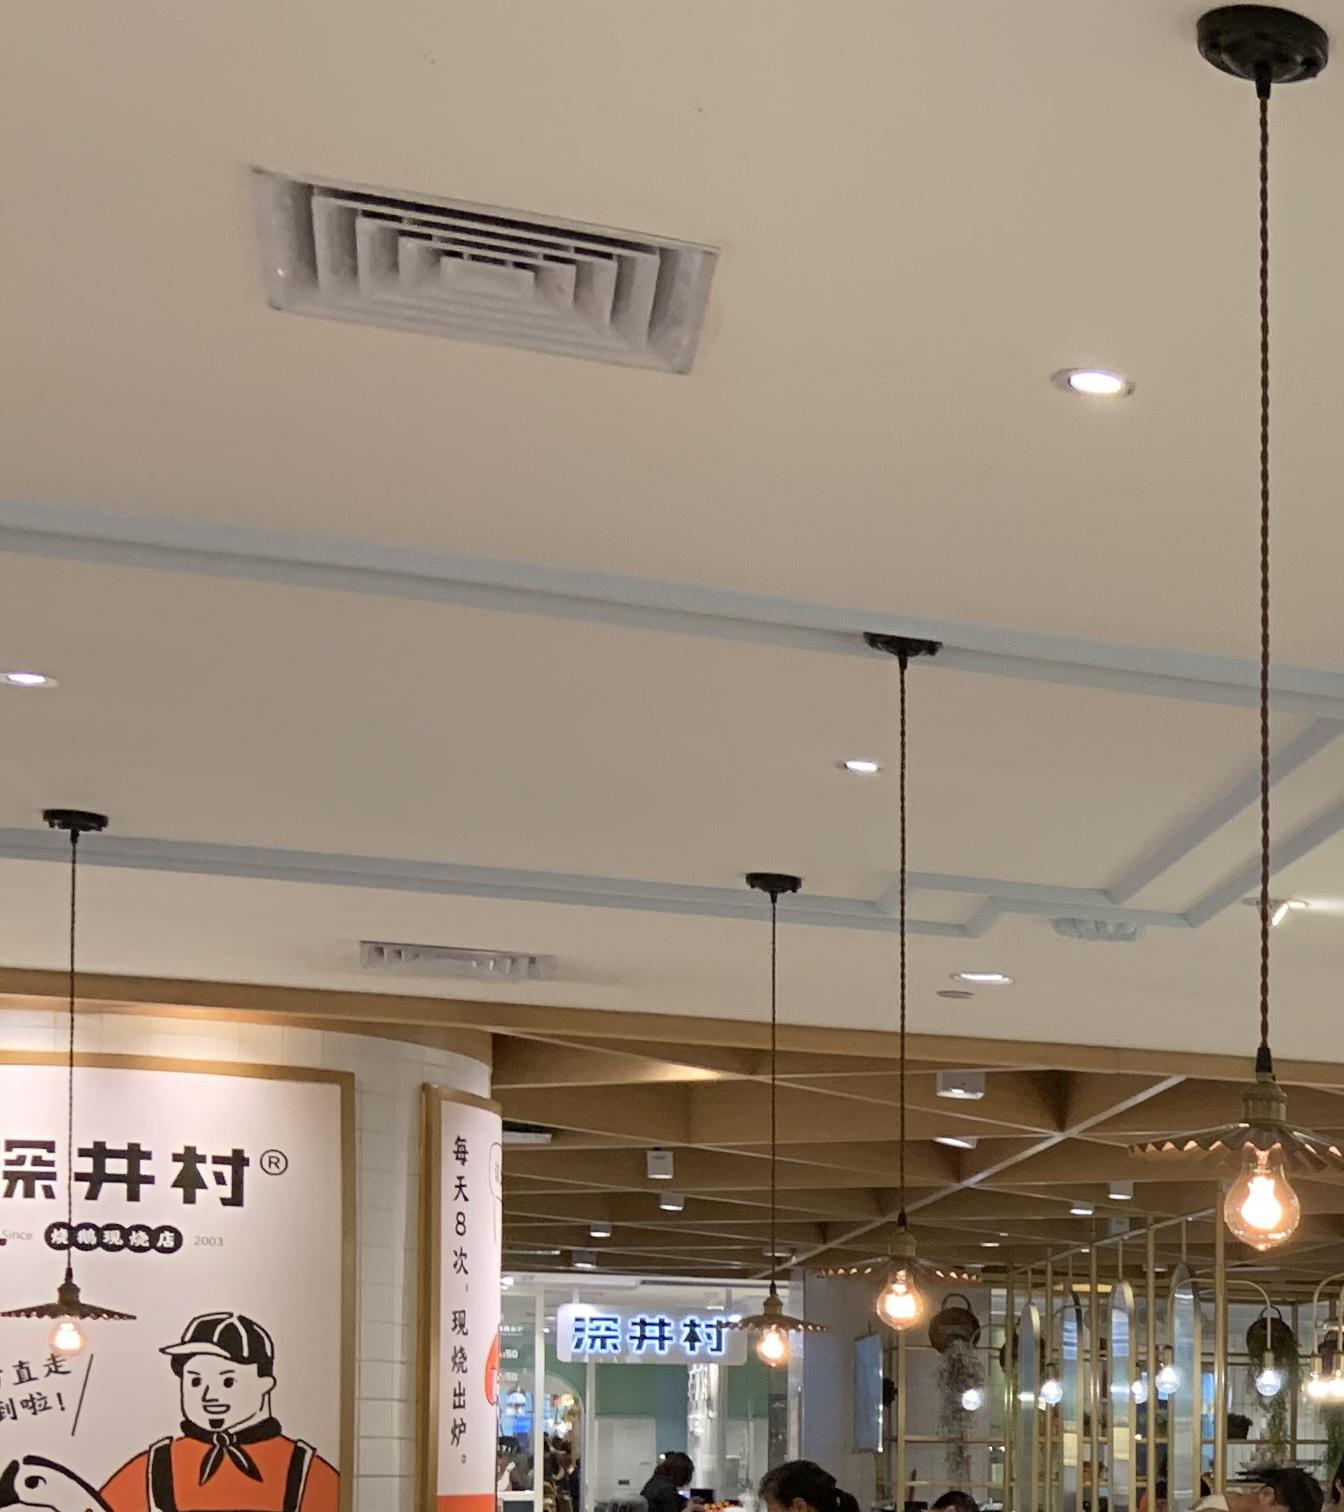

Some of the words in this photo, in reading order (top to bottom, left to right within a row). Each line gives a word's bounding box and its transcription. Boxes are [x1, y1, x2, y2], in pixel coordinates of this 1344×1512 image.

[193, 1235, 224, 1247] 2003
[572, 1315, 729, 1354] 深井村
